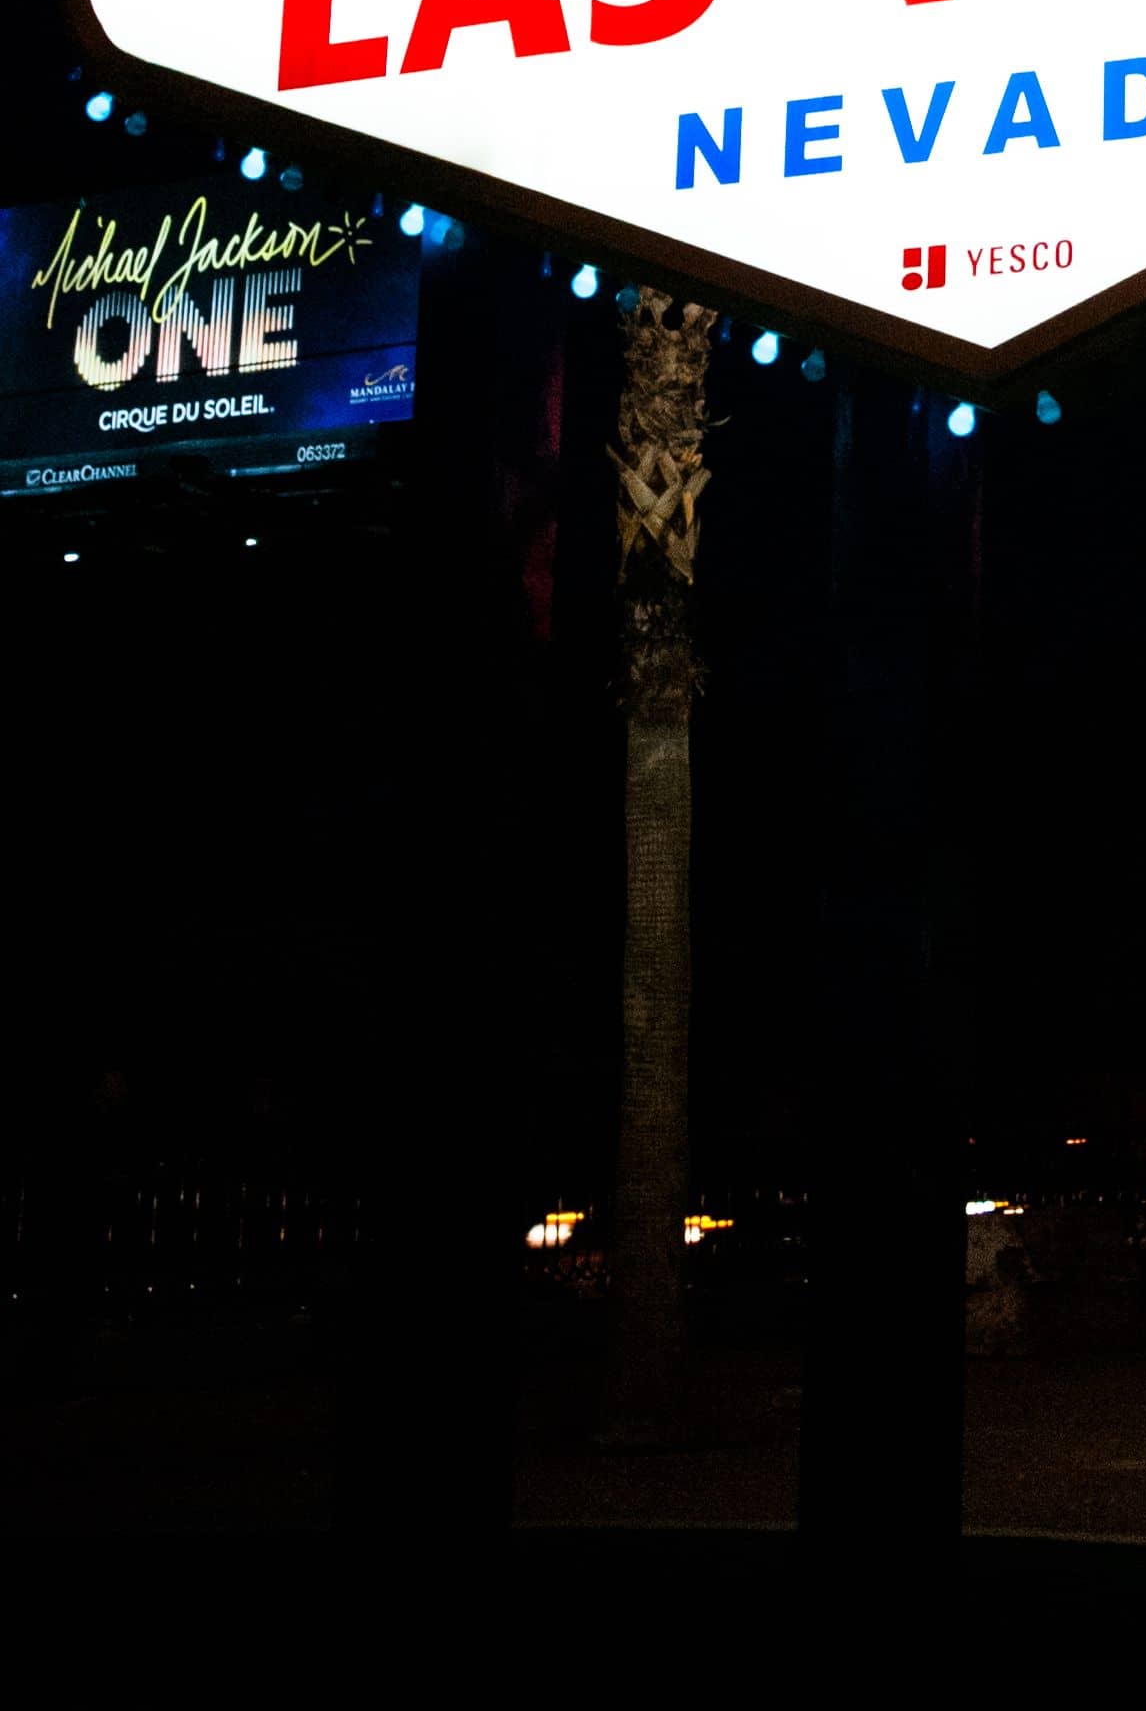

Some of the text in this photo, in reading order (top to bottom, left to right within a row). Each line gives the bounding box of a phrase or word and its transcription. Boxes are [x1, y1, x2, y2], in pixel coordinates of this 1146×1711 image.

[31, 195, 348, 330] Michael Jackson
[966, 238, 1075, 278] YESCO
[73, 266, 303, 392] ONE
[349, 383, 407, 398] MANDALAY
[98, 399, 169, 433] CIRQUE
[172, 401, 201, 424] DU
[297, 442, 346, 464] 063372
